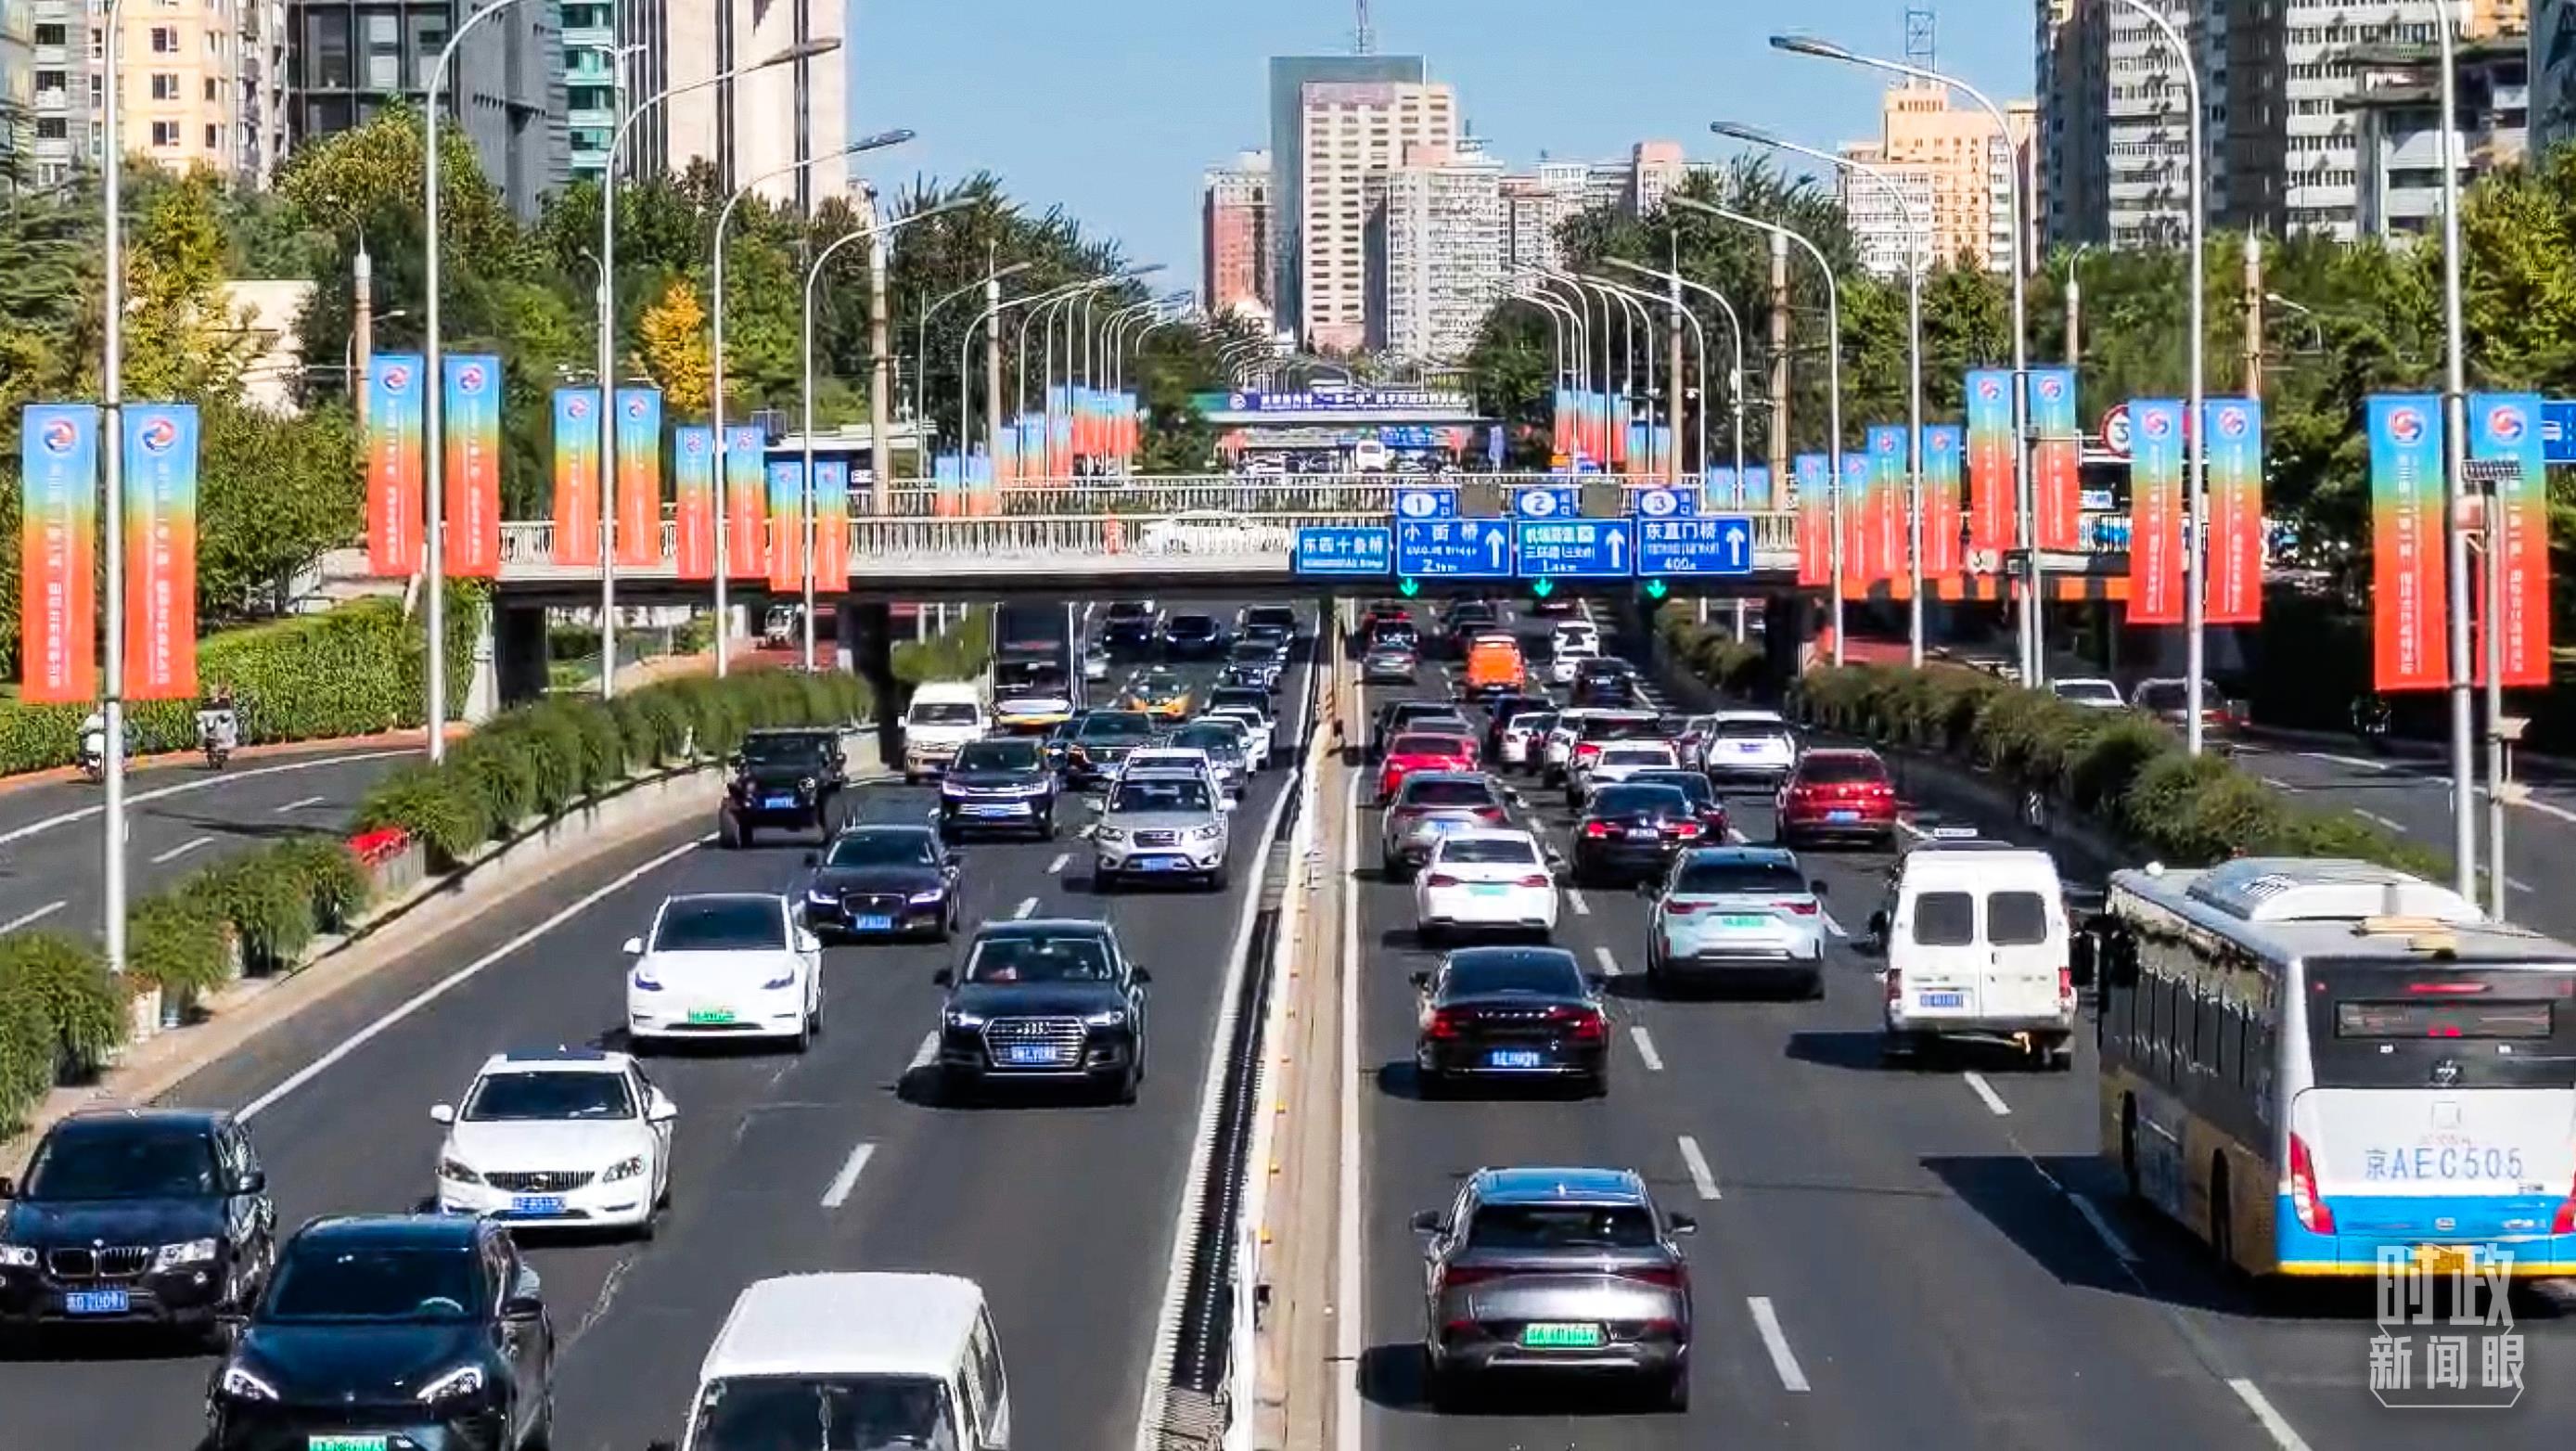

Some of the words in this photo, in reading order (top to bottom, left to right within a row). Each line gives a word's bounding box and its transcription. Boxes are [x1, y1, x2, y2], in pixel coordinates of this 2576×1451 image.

[1533, 494, 1545, 511] 2
[1653, 495, 1666, 511] 3
[2365, 1148, 2523, 1180] 京AEC505
